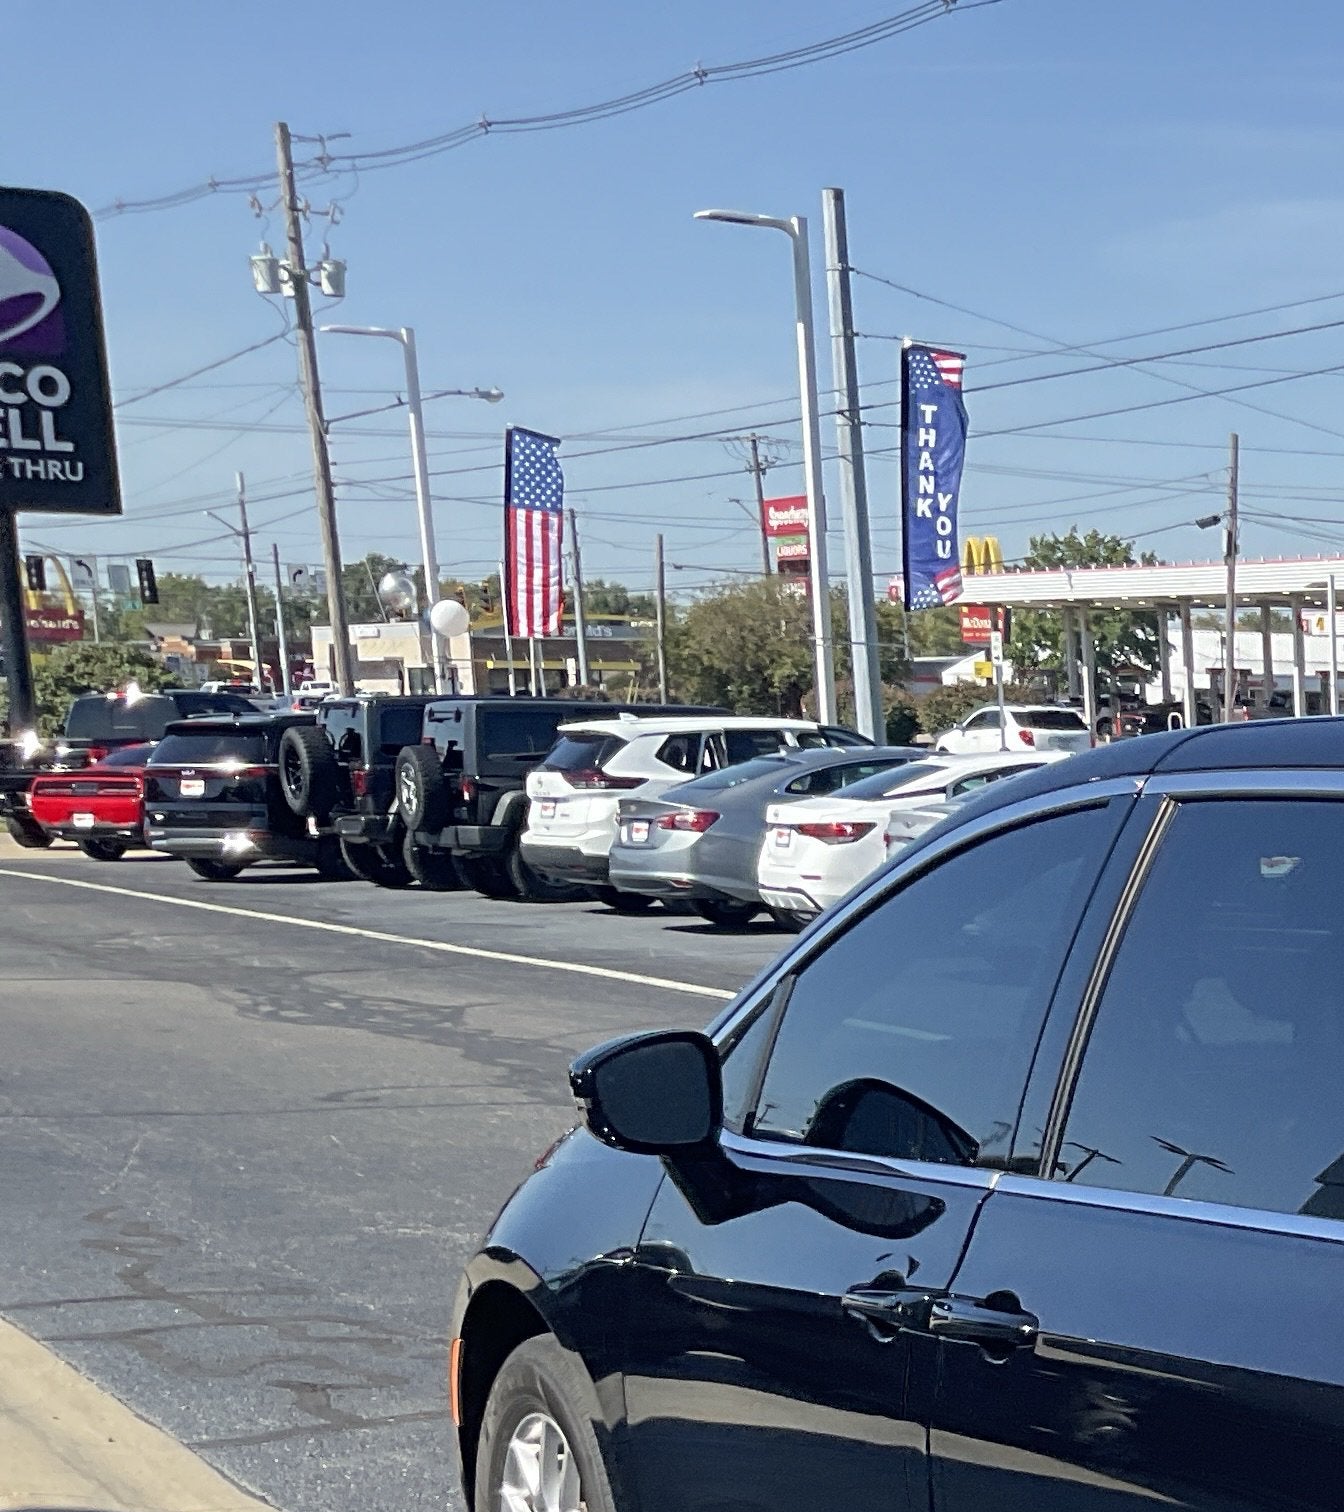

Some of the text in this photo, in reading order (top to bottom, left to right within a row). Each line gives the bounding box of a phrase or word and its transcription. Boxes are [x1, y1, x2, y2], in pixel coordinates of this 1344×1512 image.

[0, 362, 71, 407] CO
[0, 408, 74, 452] LL
[8, 456, 84, 481] THRU
[917, 404, 953, 559] THANK YOU
